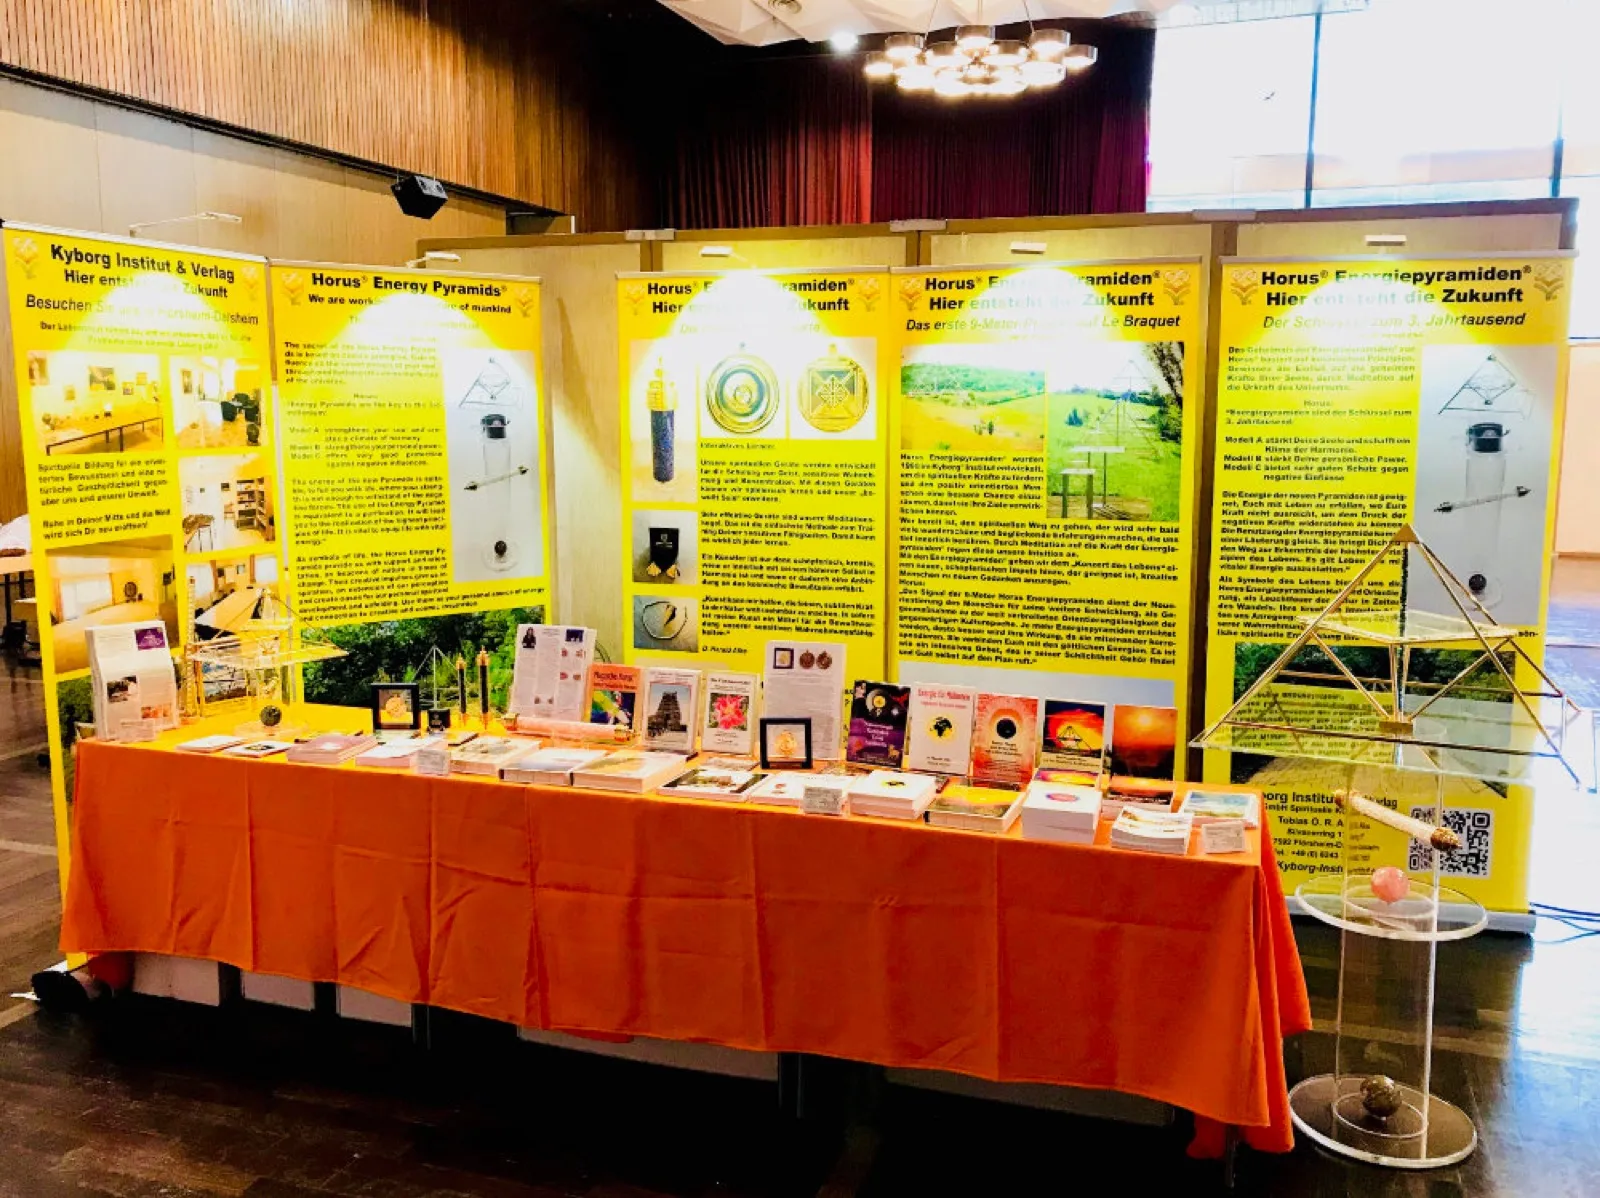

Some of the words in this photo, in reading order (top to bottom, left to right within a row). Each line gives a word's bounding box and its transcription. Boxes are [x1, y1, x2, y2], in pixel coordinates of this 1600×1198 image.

[51, 244, 111, 269] Kyborg
[116, 253, 171, 273] Institut
[176, 260, 187, 274] &
[192, 262, 235, 283] Verlag
[65, 270, 94, 284] Hier
[183, 283, 228, 298] Zukunft
[374, 276, 427, 294] Energy
[26, 294, 91, 312] Besuchen
[308, 294, 324, 303] We
[328, 295, 345, 305] are
[460, 303, 470, 311] of
[472, 303, 511, 314] mankind
[930, 297, 964, 310] Hier
[1081, 293, 1154, 306] Zukunft
[1266, 291, 1307, 305] Hier
[1404, 289, 1435, 304] die
[1442, 288, 1523, 303] Zukunft
[653, 301, 682, 313] Hier
[906, 320, 930, 330] Das
[934, 318, 966, 330] erste
[1102, 316, 1120, 327] Le
[1123, 315, 1180, 328] Braquet
[1263, 315, 1290, 329] Der
[1370, 315, 1402, 327] zum
[1408, 314, 1422, 327] 3.
[1426, 312, 1526, 327] Jahrtausend
[1029, 522, 1047, 530] Weg
[1063, 523, 1091, 531] gehen,
[995, 655, 1013, 663] Plan
[1293, 792, 1336, 803] Institu
[1266, 803, 1288, 811] mbH
[1278, 816, 1308, 825] Tobias
